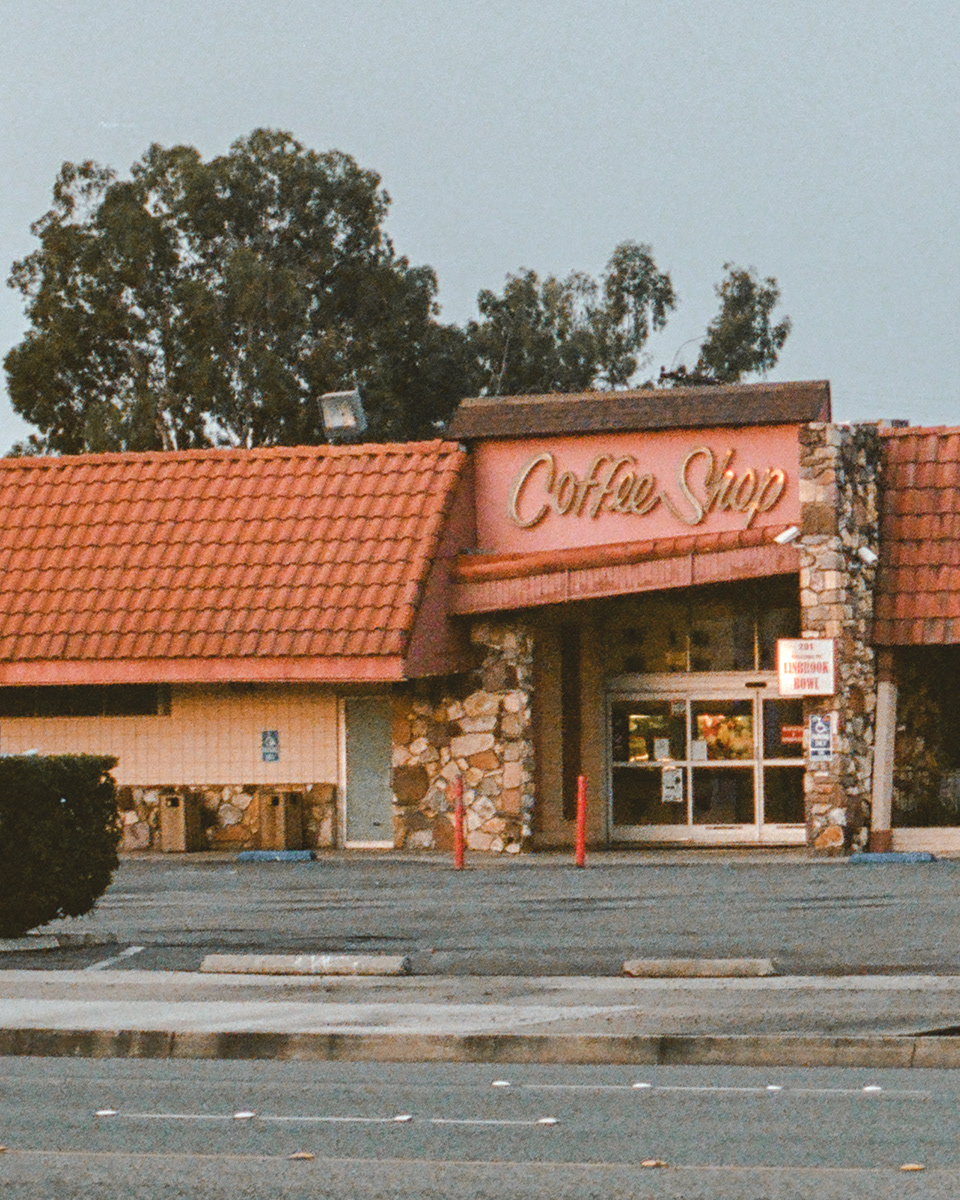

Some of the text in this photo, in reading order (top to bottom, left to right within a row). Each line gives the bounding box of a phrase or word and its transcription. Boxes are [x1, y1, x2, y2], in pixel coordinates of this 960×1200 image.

[507, 446, 787, 529] Coffee Shop
[793, 677, 820, 690] BOWL
